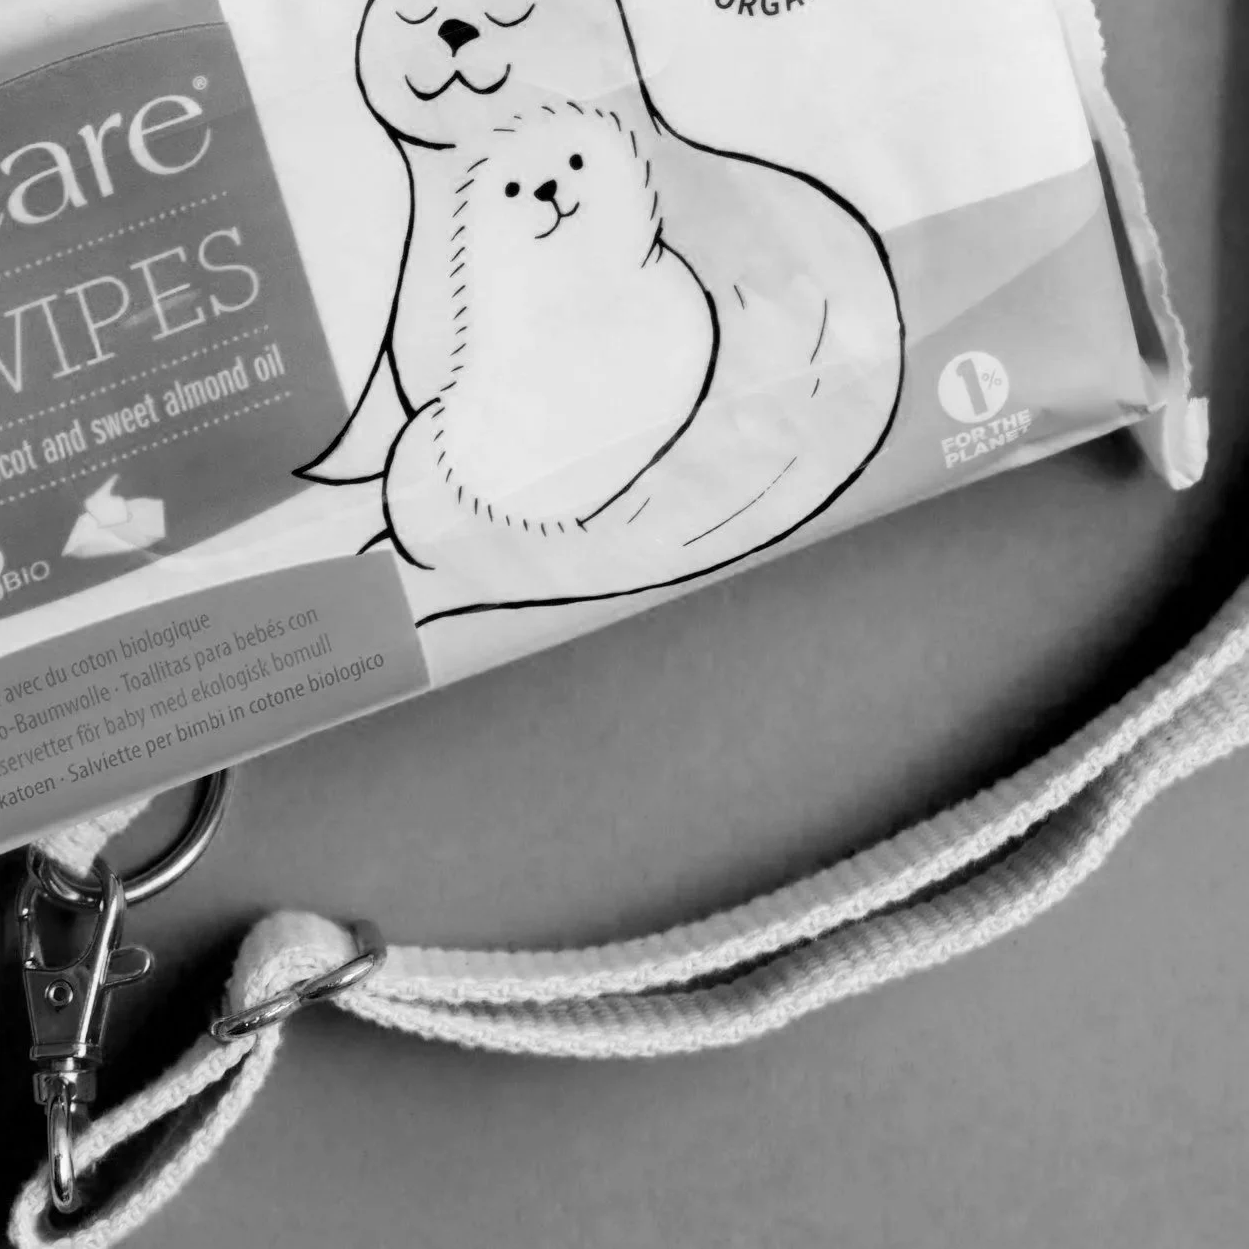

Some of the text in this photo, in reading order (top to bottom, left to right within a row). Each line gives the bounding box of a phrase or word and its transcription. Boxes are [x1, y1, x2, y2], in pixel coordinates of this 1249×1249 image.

[41, 419, 88, 464] and
[90, 394, 161, 445] sweet
[163, 356, 250, 418] almond
[253, 343, 286, 382] oil
[955, 358, 1003, 417] 1%
[940, 407, 1032, 454] FOR THE
[944, 423, 1031, 469] PLANET
[2, 560, 51, 593] BIO
[4, 675, 43, 703] avec
[45, 666, 68, 689] du
[70, 647, 119, 678] coton
[119, 613, 212, 659] biologique
[76, 723, 102, 747] för
[103, 706, 146, 737] baby
[150, 688, 188, 719] med
[190, 656, 272, 703] ekologisk
[270, 632, 333, 673] bomull
[119, 655, 192, 693] Toallitas
[194, 640, 233, 671] para
[233, 618, 286, 649] bebés
[287, 608, 320, 632] con
[67, 742, 143, 783] Salviette
[144, 731, 172, 759] per
[175, 710, 226, 743] bimbi
[228, 704, 246, 724] in
[248, 681, 306, 715] cotone
[307, 652, 386, 692] biologico
